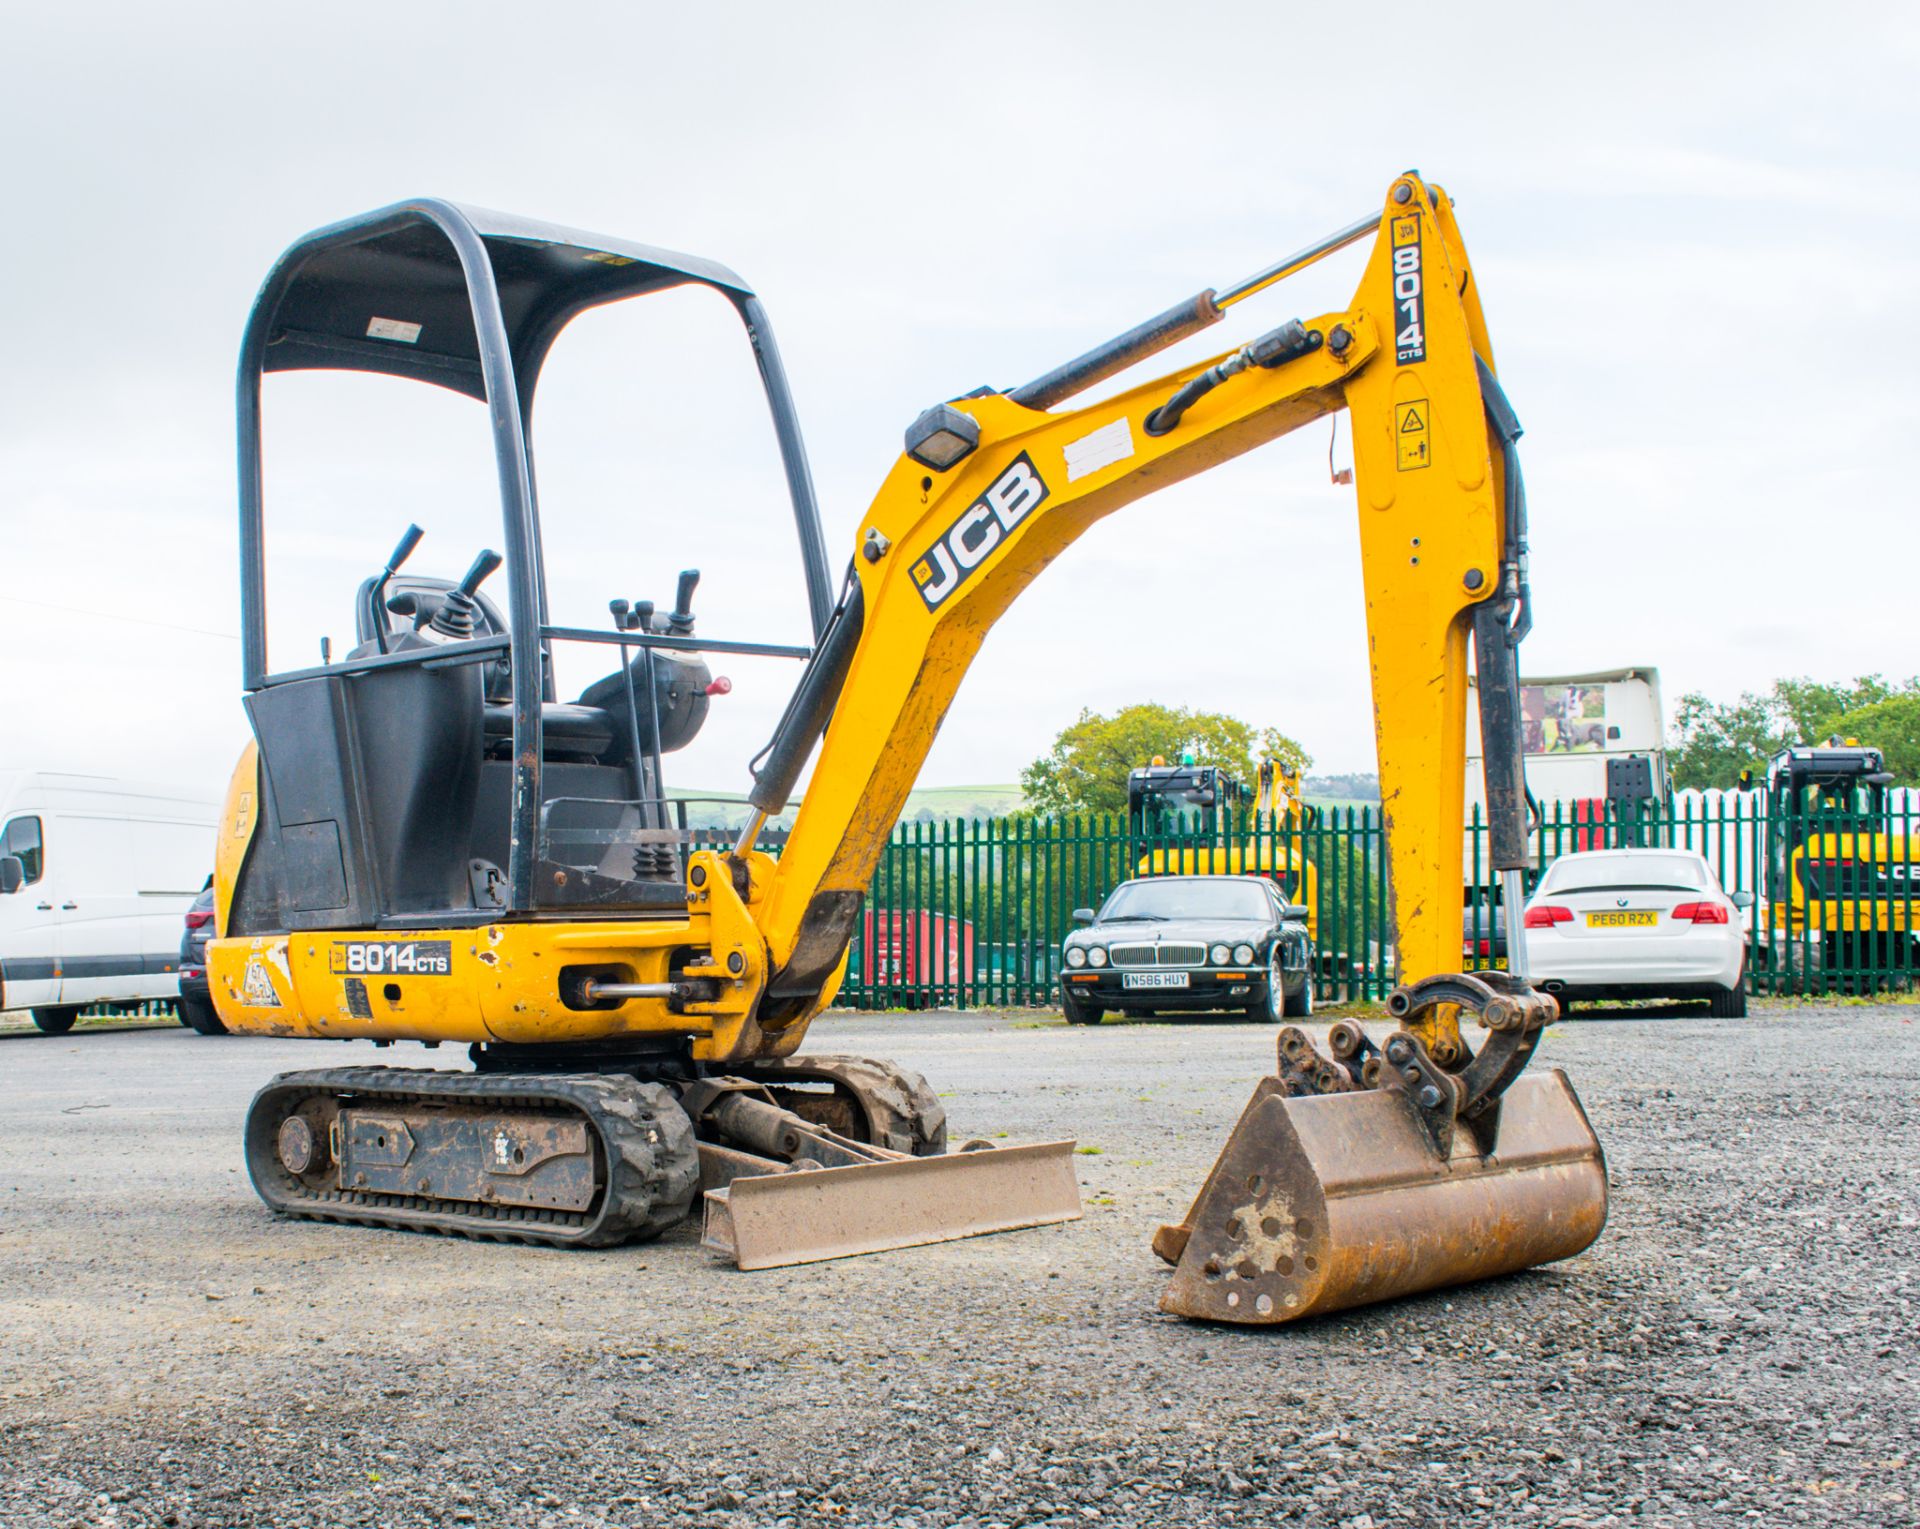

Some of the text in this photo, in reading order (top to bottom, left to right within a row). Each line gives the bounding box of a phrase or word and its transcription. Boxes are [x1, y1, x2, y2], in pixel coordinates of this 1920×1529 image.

[1394, 246, 1423, 348] 8014
[923, 461, 1043, 604] JCB
[1593, 913, 1653, 925] PE60 RZX
[1164, 974, 1187, 985] HUY
